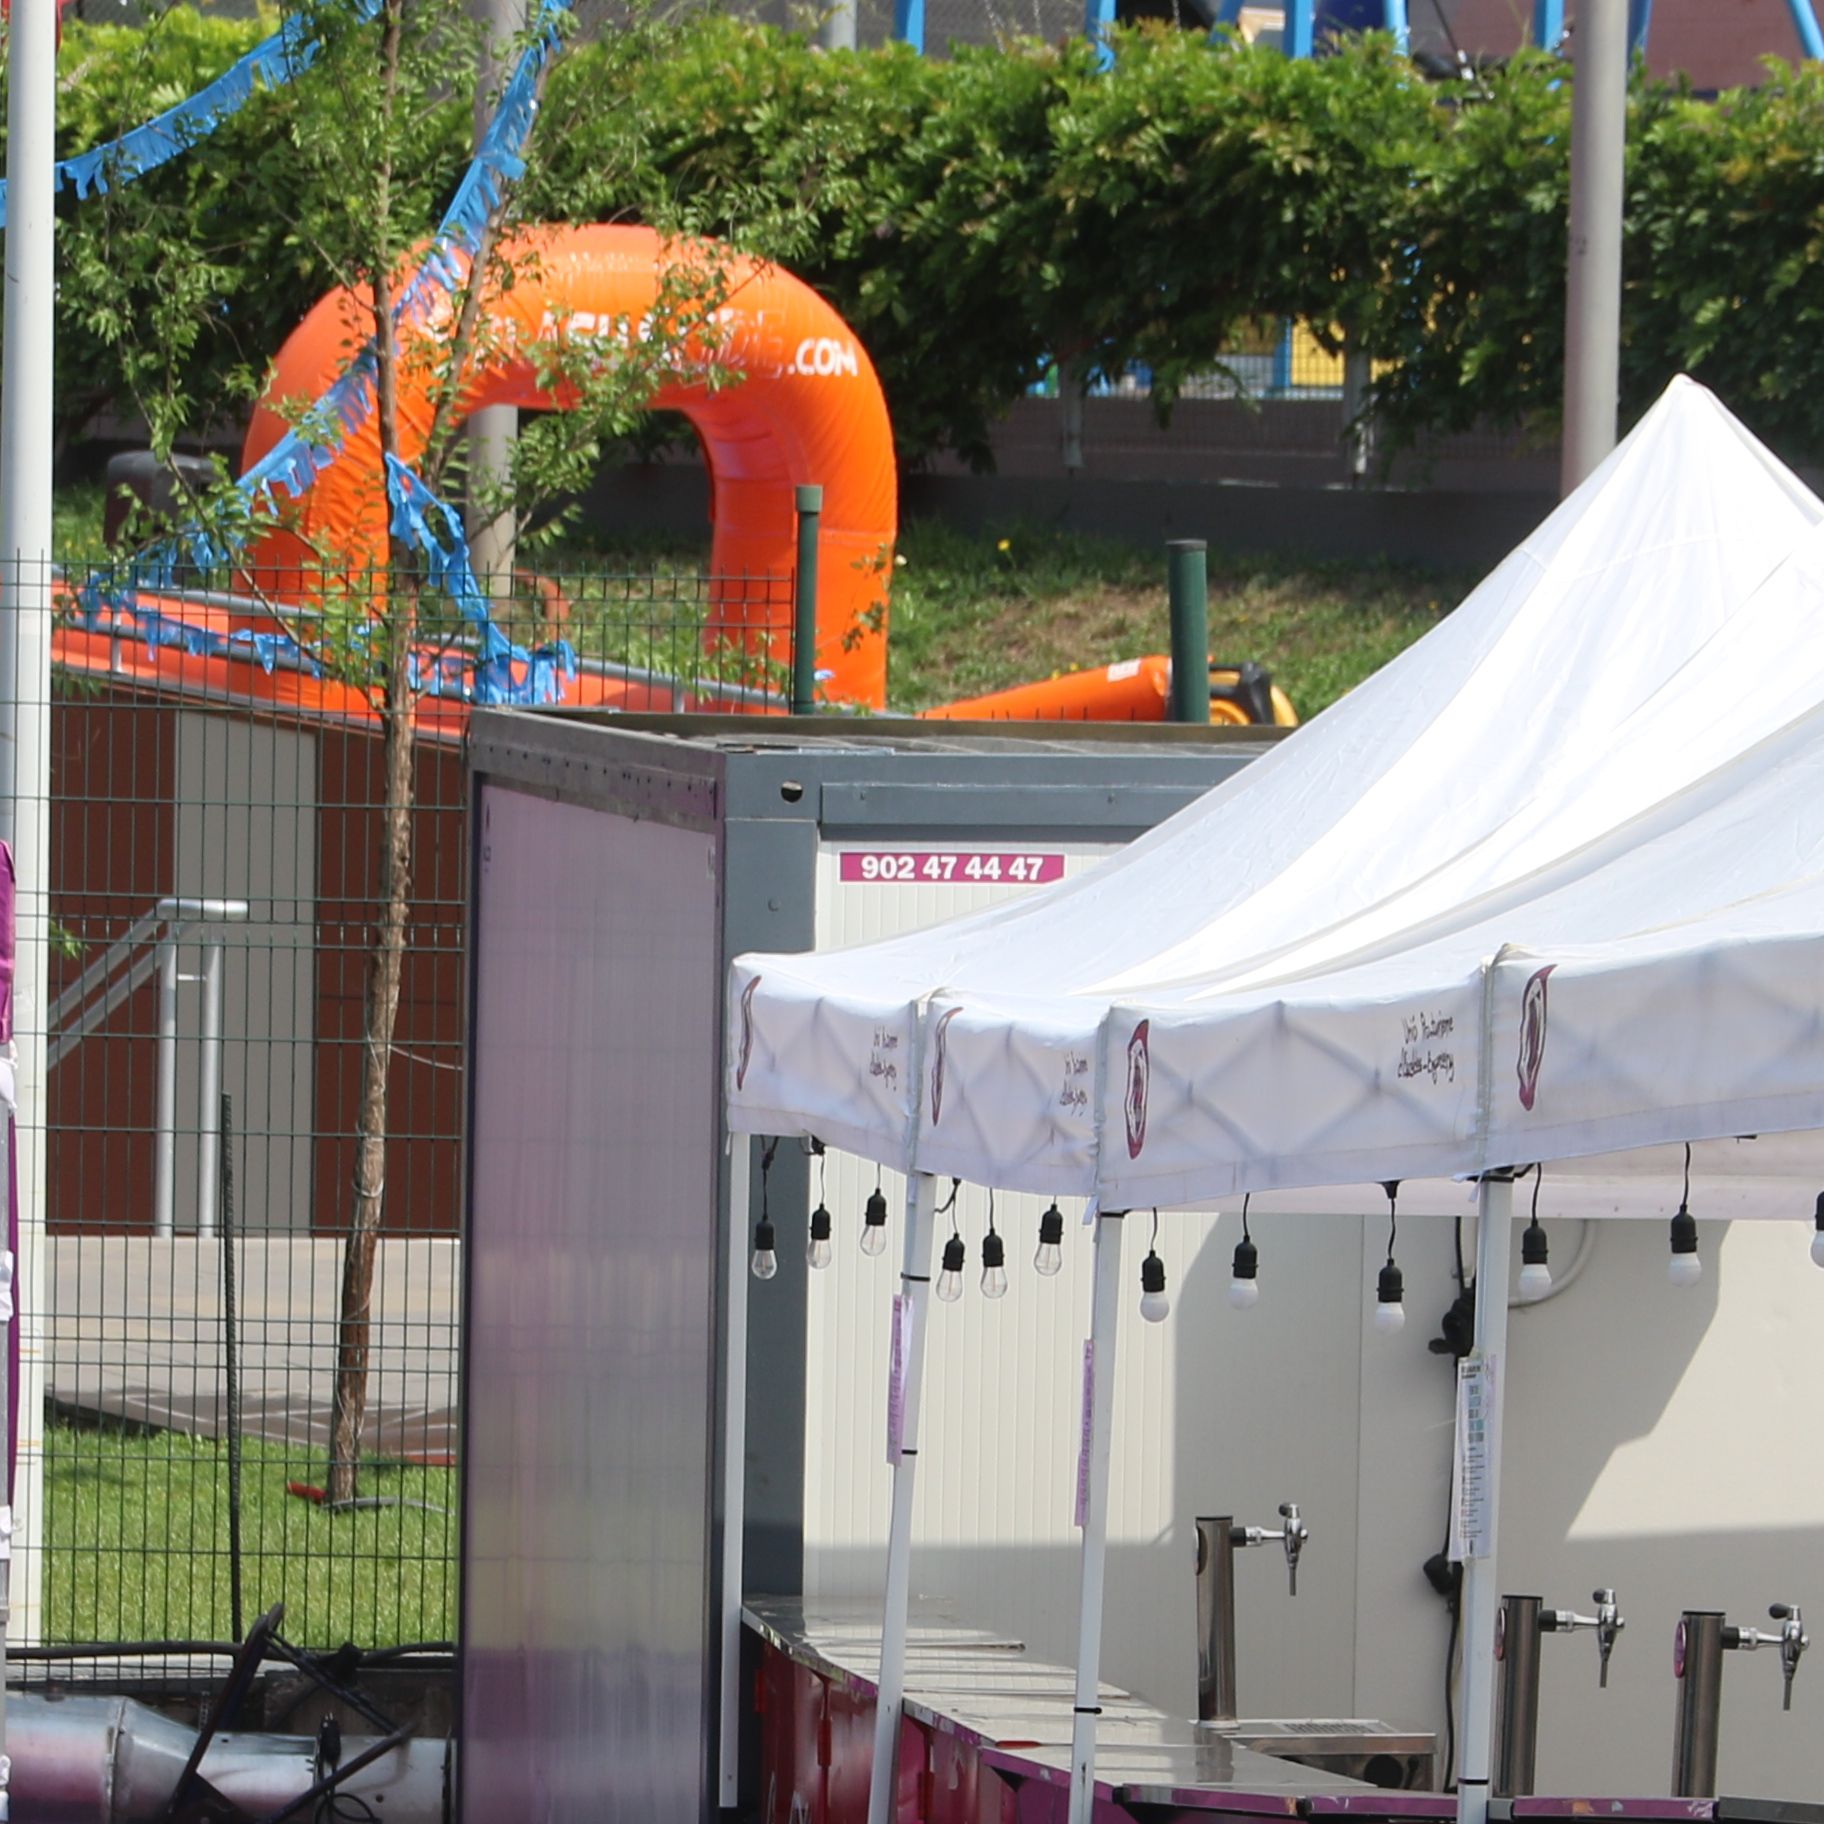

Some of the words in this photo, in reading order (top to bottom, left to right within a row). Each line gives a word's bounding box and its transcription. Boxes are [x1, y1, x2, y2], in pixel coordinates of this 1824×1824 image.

[860, 853, 917, 882] 902
[923, 853, 960, 882] 47
[964, 853, 1003, 882] 44
[1007, 853, 1044, 882] 47
